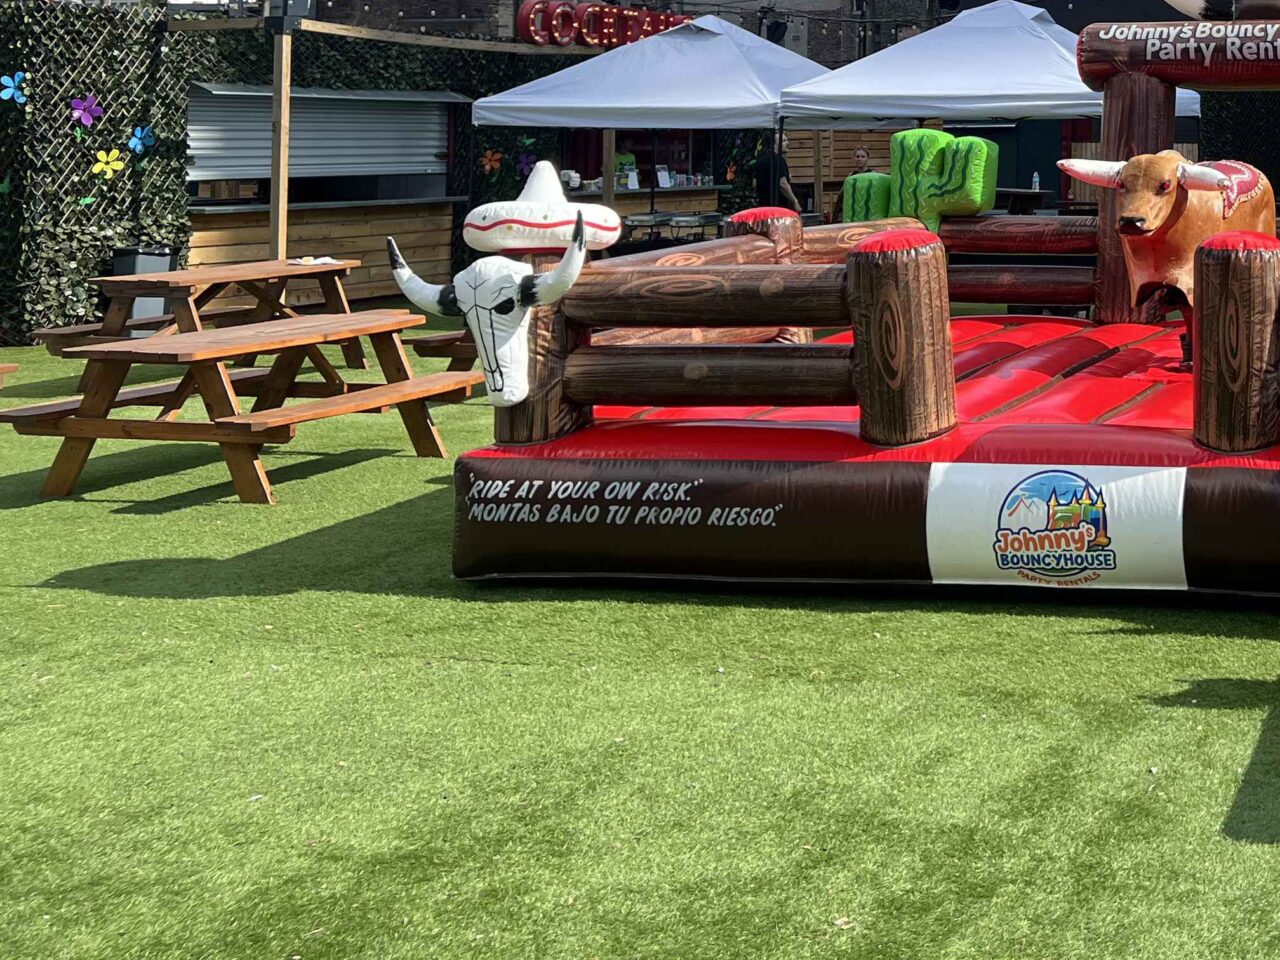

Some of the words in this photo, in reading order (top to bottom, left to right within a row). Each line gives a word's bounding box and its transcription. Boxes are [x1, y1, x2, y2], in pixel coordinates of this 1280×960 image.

[1099, 23, 1193, 40] Johnny's
[1145, 38, 1216, 67] Party
[515, 479, 544, 499] AT
[547, 480, 601, 500] YOUR
[545, 503, 601, 524] BAJO
[605, 504, 633, 525] TU
[634, 505, 702, 526] PROPIO
[997, 524, 1094, 553] Johnny's
[999, 553, 1113, 568] BOUNCYHOUSE
[1017, 569, 1053, 586] PARTY
[1056, 570, 1101, 587] RENTALS
